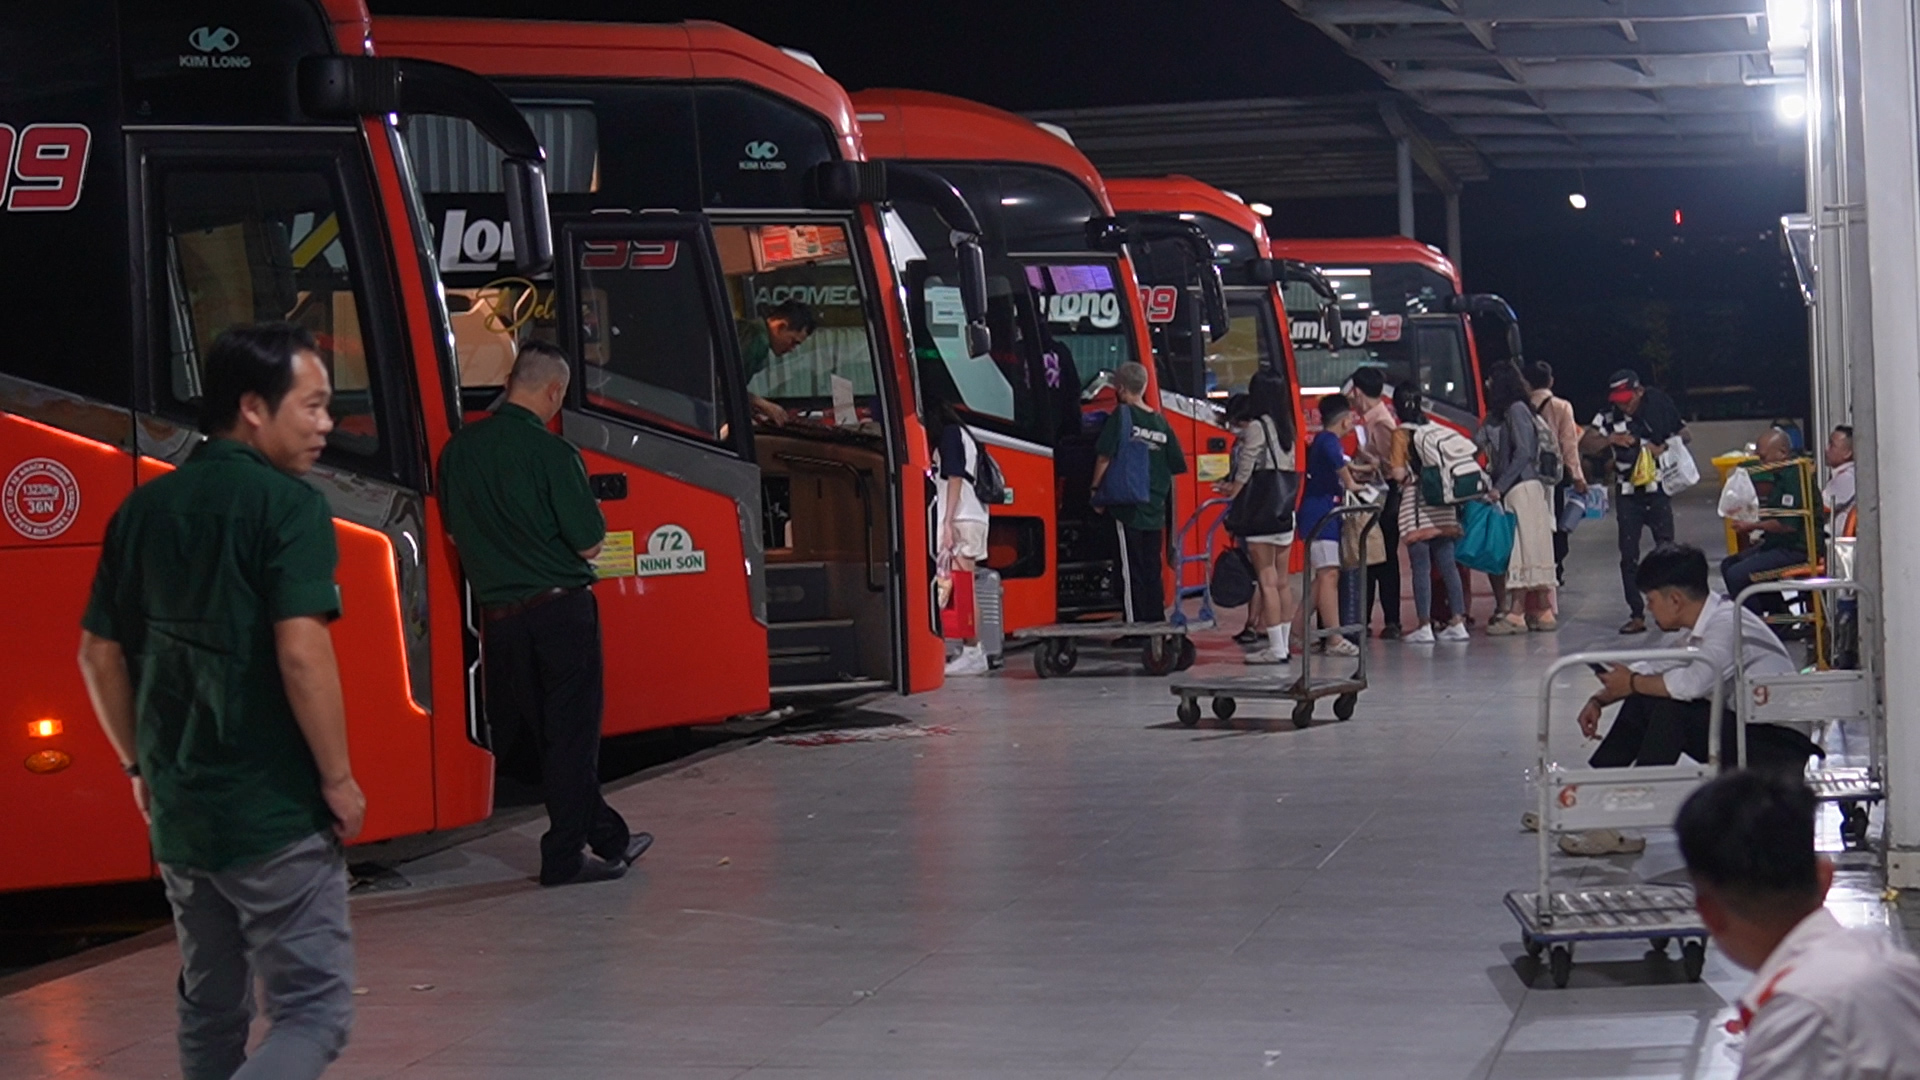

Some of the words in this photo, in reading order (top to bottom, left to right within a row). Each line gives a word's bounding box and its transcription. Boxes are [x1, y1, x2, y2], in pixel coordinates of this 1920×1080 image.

[179, 54, 209, 68] KIM
[211, 55, 252, 68] LONG
[0, 123, 91, 211] 9
[760, 161, 787, 170] LONG
[439, 209, 516, 272] Lo
[1319, 314, 1368, 345] Lng
[1367, 314, 1402, 341] 99
[28, 501, 54, 514] 36N
[656, 530, 684, 551] 72
[640, 556, 672, 571] NINH
[1752, 685, 1769, 707] 9
[1559, 784, 1578, 808] 6
